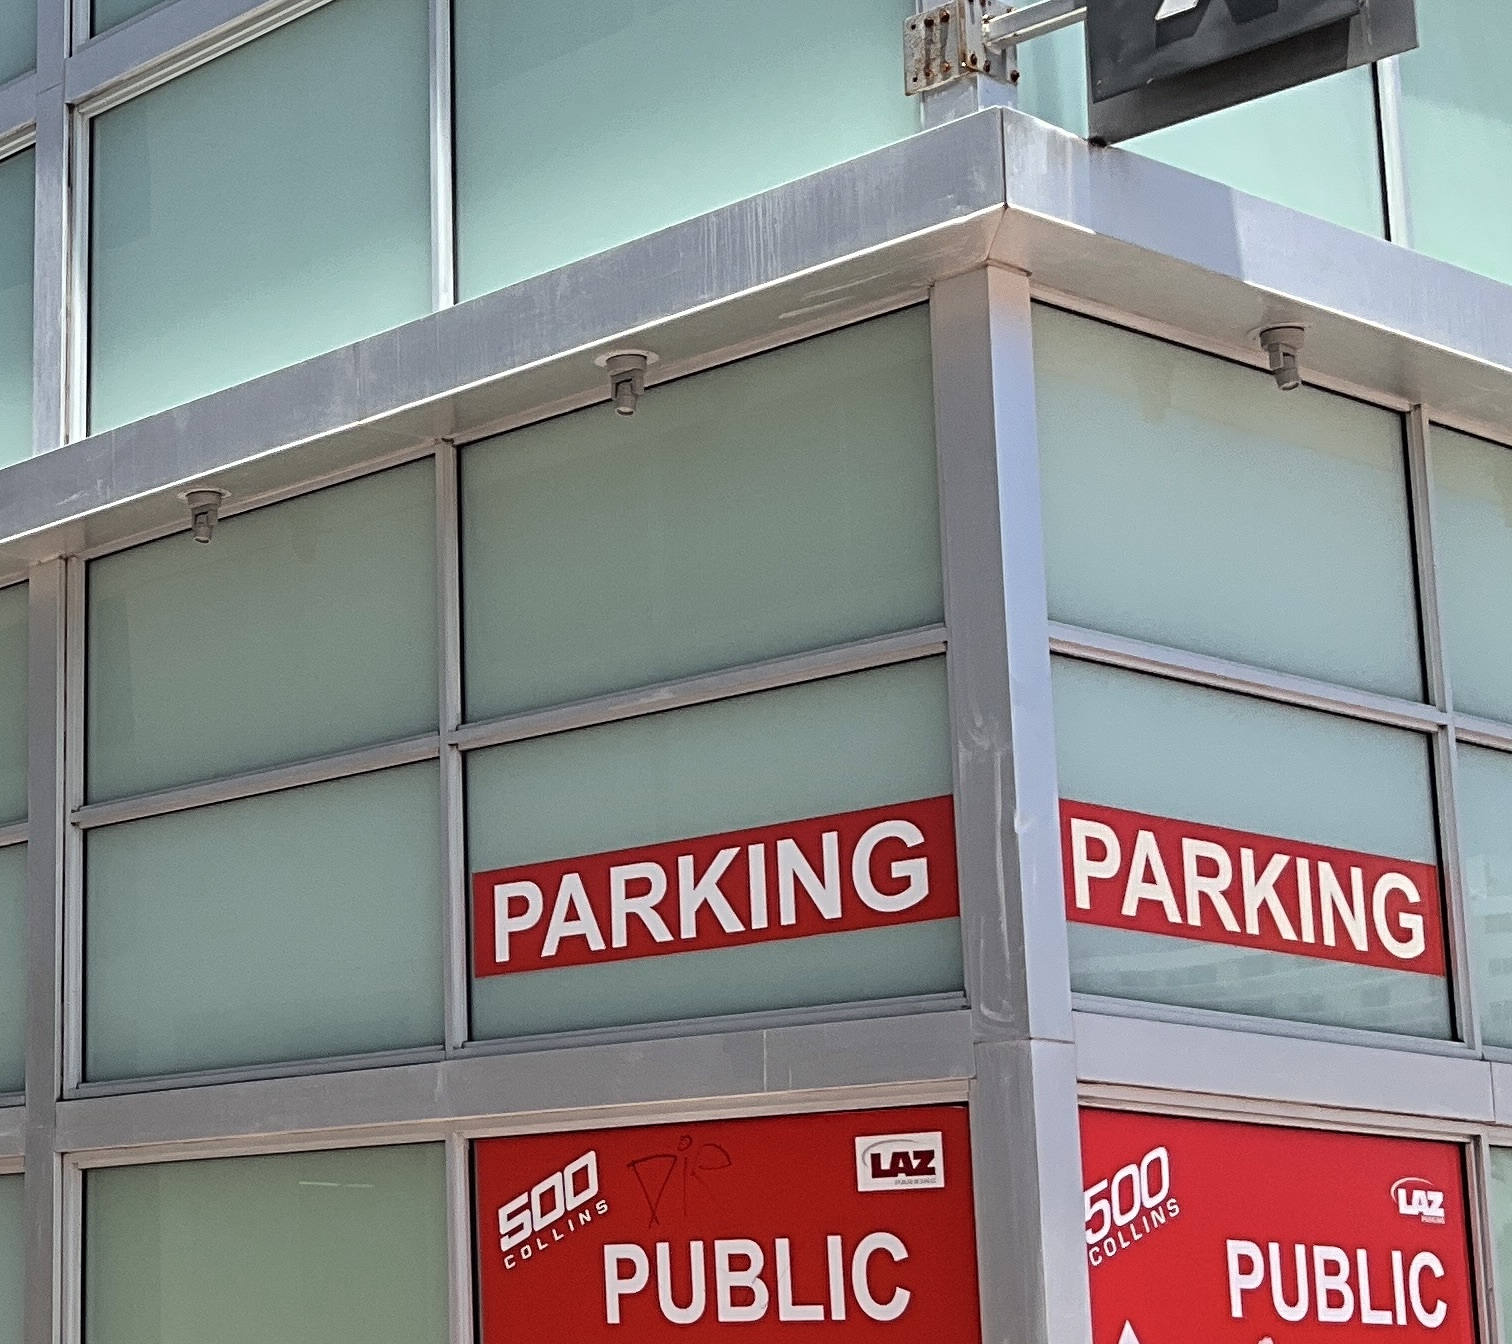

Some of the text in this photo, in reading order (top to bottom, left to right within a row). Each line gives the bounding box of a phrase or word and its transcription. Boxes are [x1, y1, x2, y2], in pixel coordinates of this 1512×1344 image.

[493, 819, 930, 964] PARKING
[1069, 816, 1426, 960] PARKING
[497, 1150, 599, 1252] 500
[870, 1149, 937, 1179] LAZ
[1084, 1146, 1170, 1245] 500
[1397, 1187, 1445, 1217] LAZ
[504, 1199, 609, 1270] COLLINS
[603, 1231, 912, 1325] PUBLIC
[1088, 1198, 1180, 1267] COLLINS
[1226, 1238, 1448, 1329] PUBLIC
